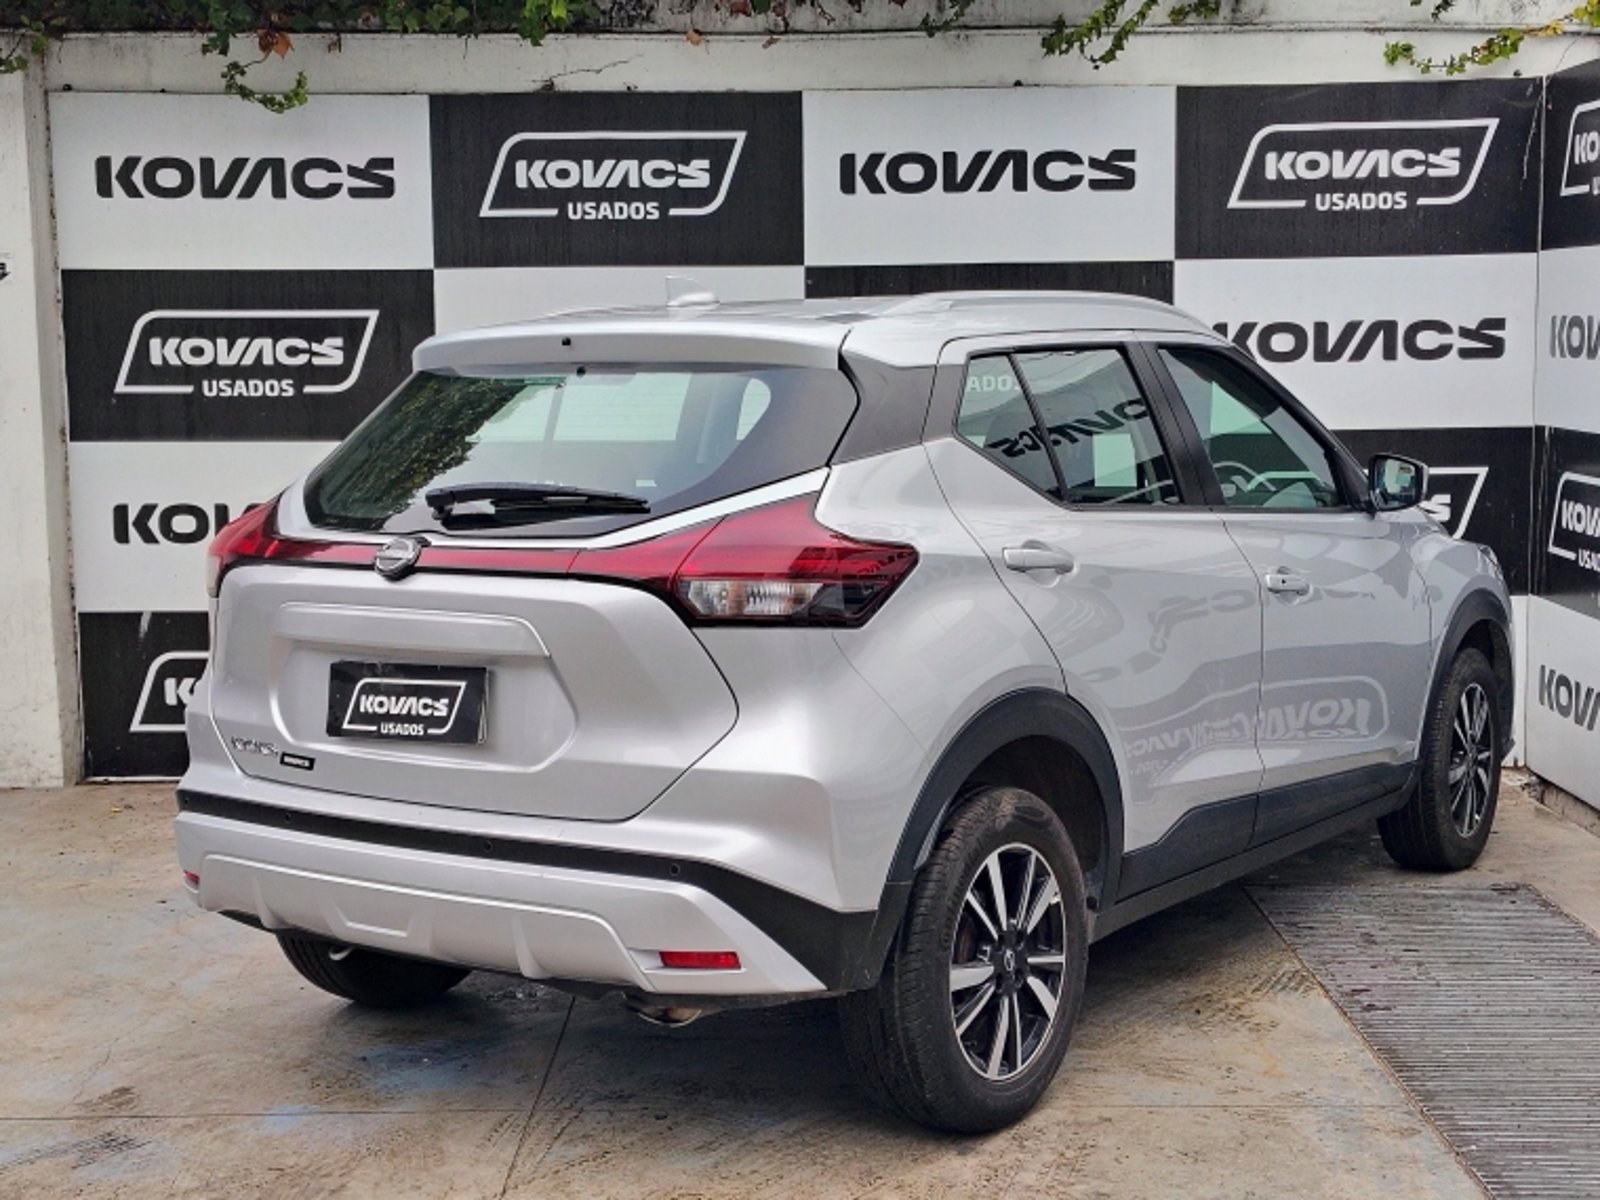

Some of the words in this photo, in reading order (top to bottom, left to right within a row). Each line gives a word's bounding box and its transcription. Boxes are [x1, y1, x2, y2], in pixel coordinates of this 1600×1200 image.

[1574, 131, 1600, 164] KO
[515, 159, 710, 189] KOVACS
[839, 148, 1136, 195] KOVACS
[1264, 147, 1461, 180] KOVACS
[95, 155, 395, 199] KOVACS
[567, 201, 660, 220] USADOS
[1315, 191, 1408, 211] USADOS
[149, 337, 344, 366] KOVACS
[202, 379, 295, 397] USADOS
[966, 376, 1021, 392] ADO
[359, 694, 449, 717] KOVACS
[380, 722, 424, 736] USADOS
